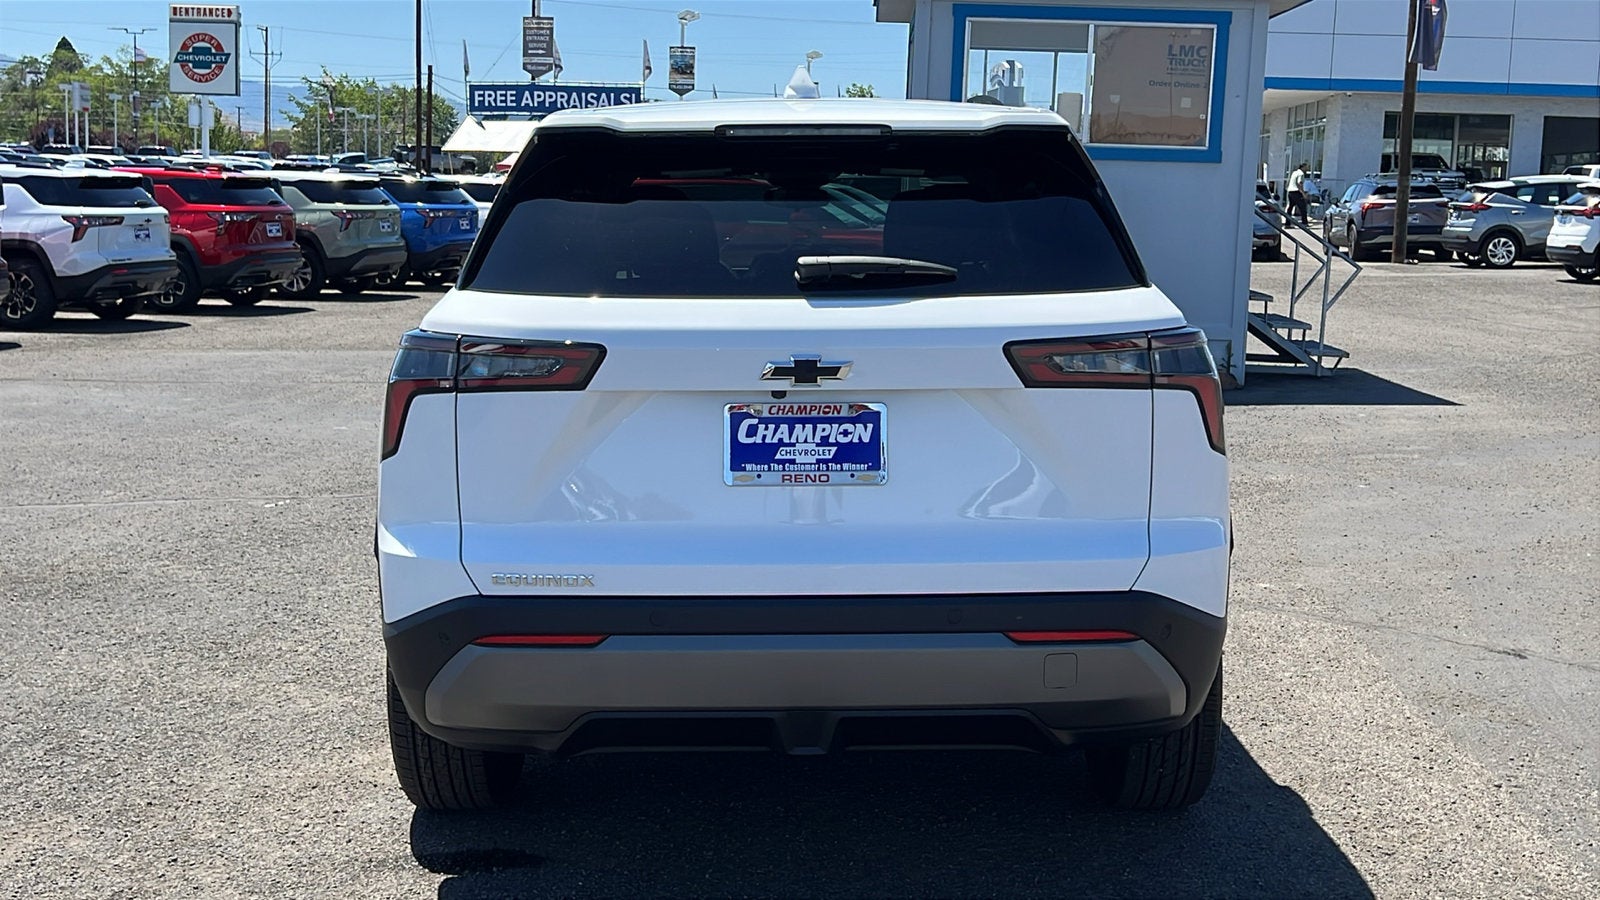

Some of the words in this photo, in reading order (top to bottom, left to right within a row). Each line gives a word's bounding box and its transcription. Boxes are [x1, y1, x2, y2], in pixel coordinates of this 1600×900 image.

[179, 7, 226, 18] ENTRANCE
[185, 34, 218, 47] SUPER
[1167, 44, 1208, 58] LMC
[177, 54, 227, 62] CHEVROLET
[1167, 57, 1207, 67] TRUCK
[183, 65, 222, 82] SERVICE
[1148, 80, 1172, 88] Order
[1173, 81, 1201, 89] Online
[474, 90, 516, 107] FREE
[768, 404, 842, 416] CHAMPION
[737, 418, 874, 444] CHAMPION
[779, 448, 833, 457] CHEVROLET
[770, 463, 783, 471] The
[784, 463, 818, 471] Customer
[820, 463, 827, 471] Is
[828, 463, 842, 471] The
[781, 473, 830, 483] RENO
[491, 573, 595, 587] EQUINOX
